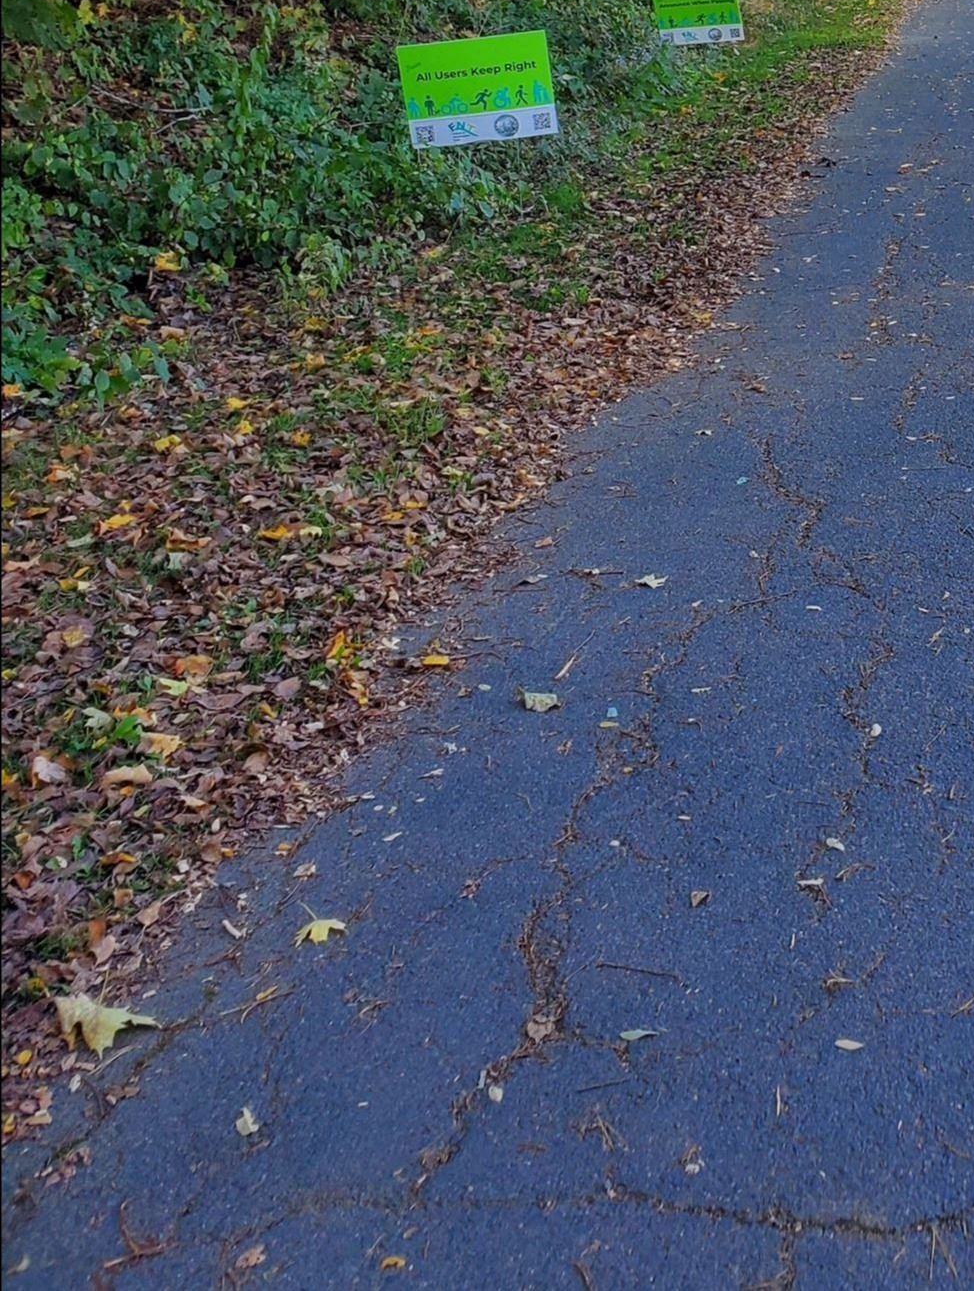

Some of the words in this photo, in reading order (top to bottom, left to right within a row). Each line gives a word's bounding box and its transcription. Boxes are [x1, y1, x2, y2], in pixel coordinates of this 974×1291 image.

[416, 72, 432, 82] All
[435, 69, 468, 80] Users
[471, 66, 501, 76] Keep
[504, 61, 536, 72] Right
